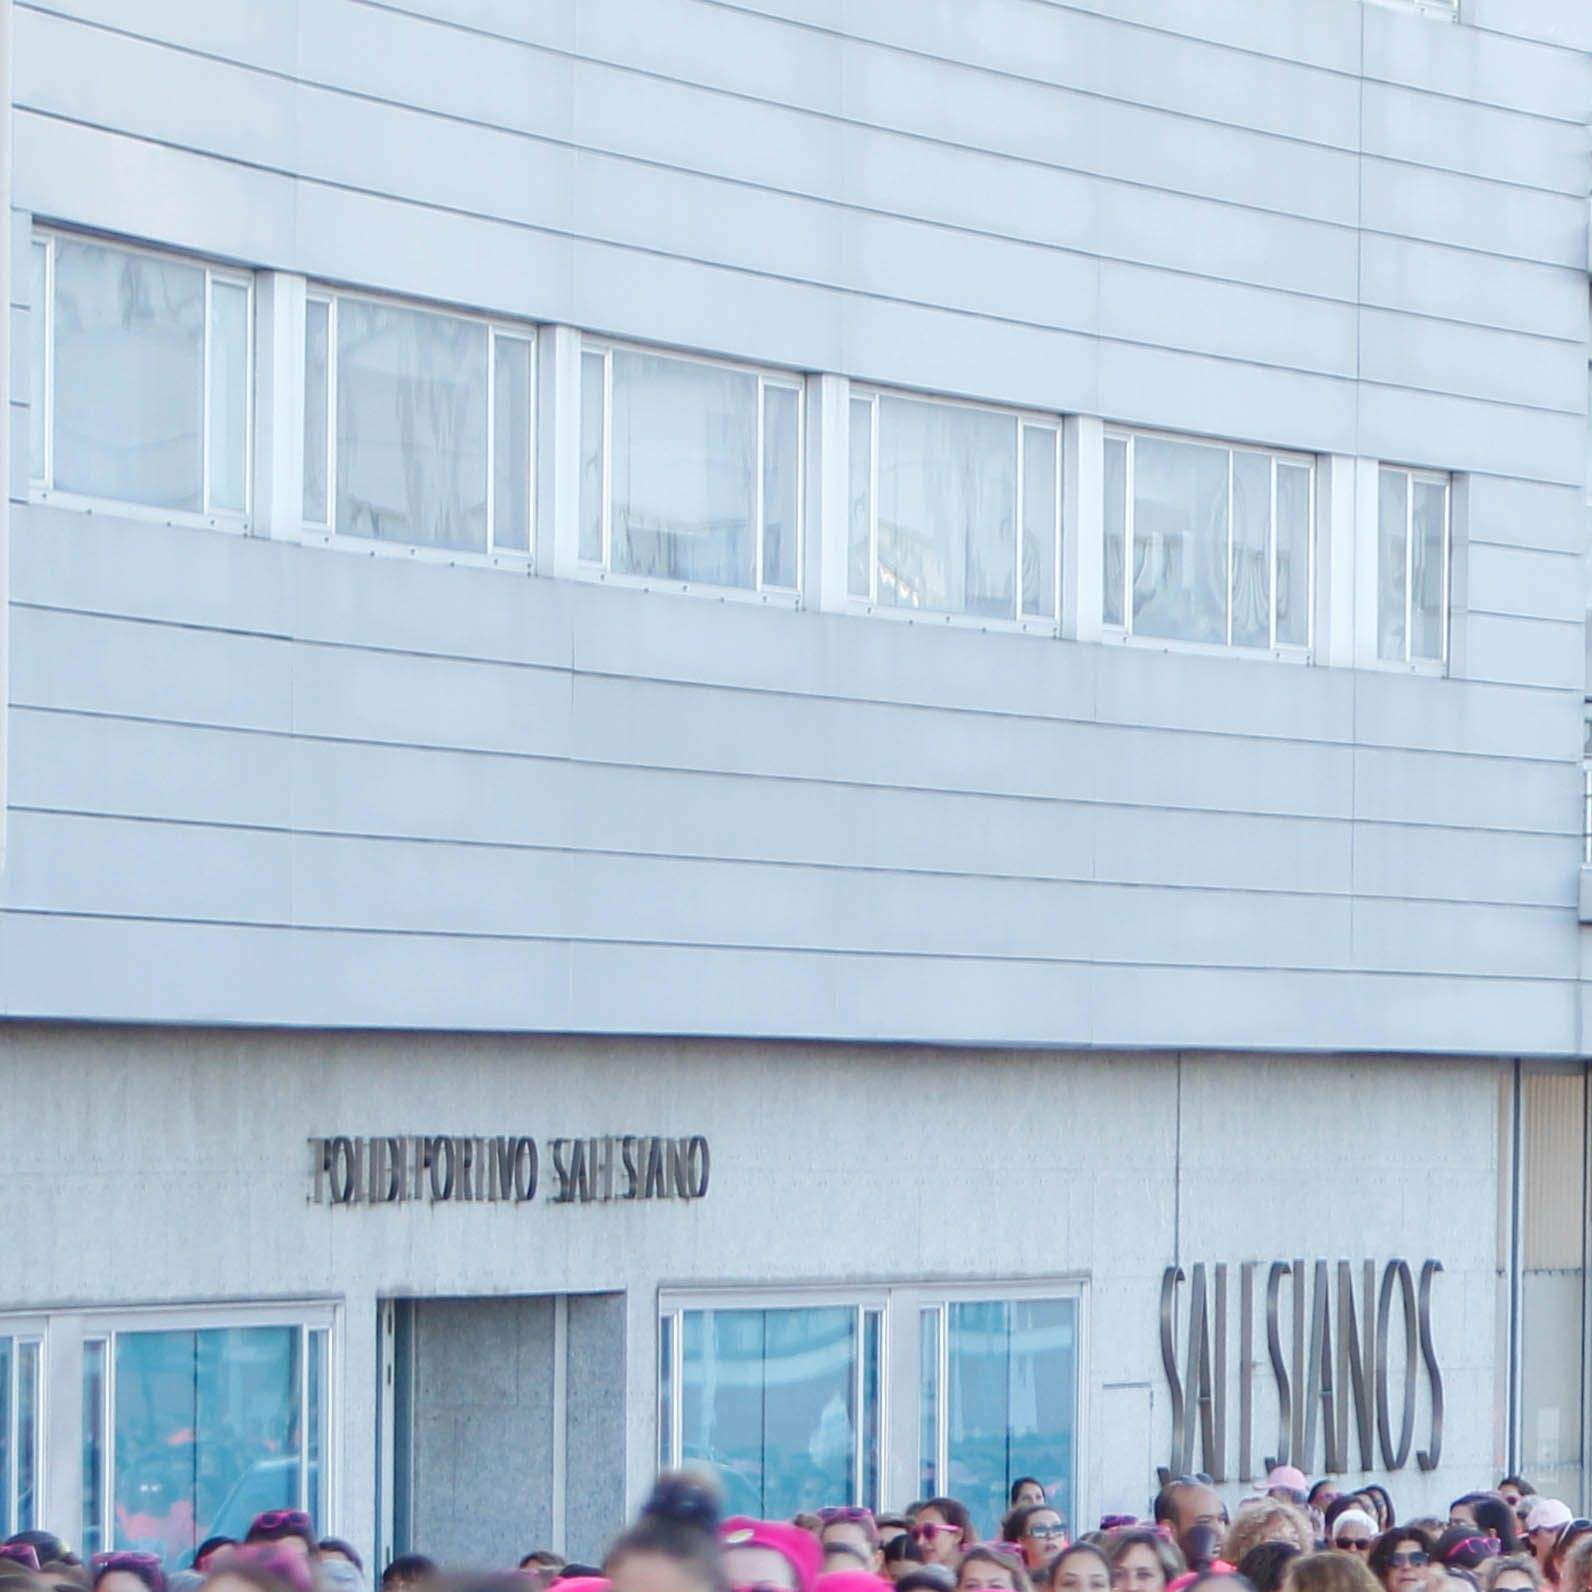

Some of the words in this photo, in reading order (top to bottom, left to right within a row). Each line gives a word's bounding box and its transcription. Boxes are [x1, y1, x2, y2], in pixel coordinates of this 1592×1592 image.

[307, 1135, 539, 1205] POLIDEPORTIVO
[545, 1135, 711, 1205] SALESIANO
[1156, 1257, 1445, 1485] SALESIANOS
